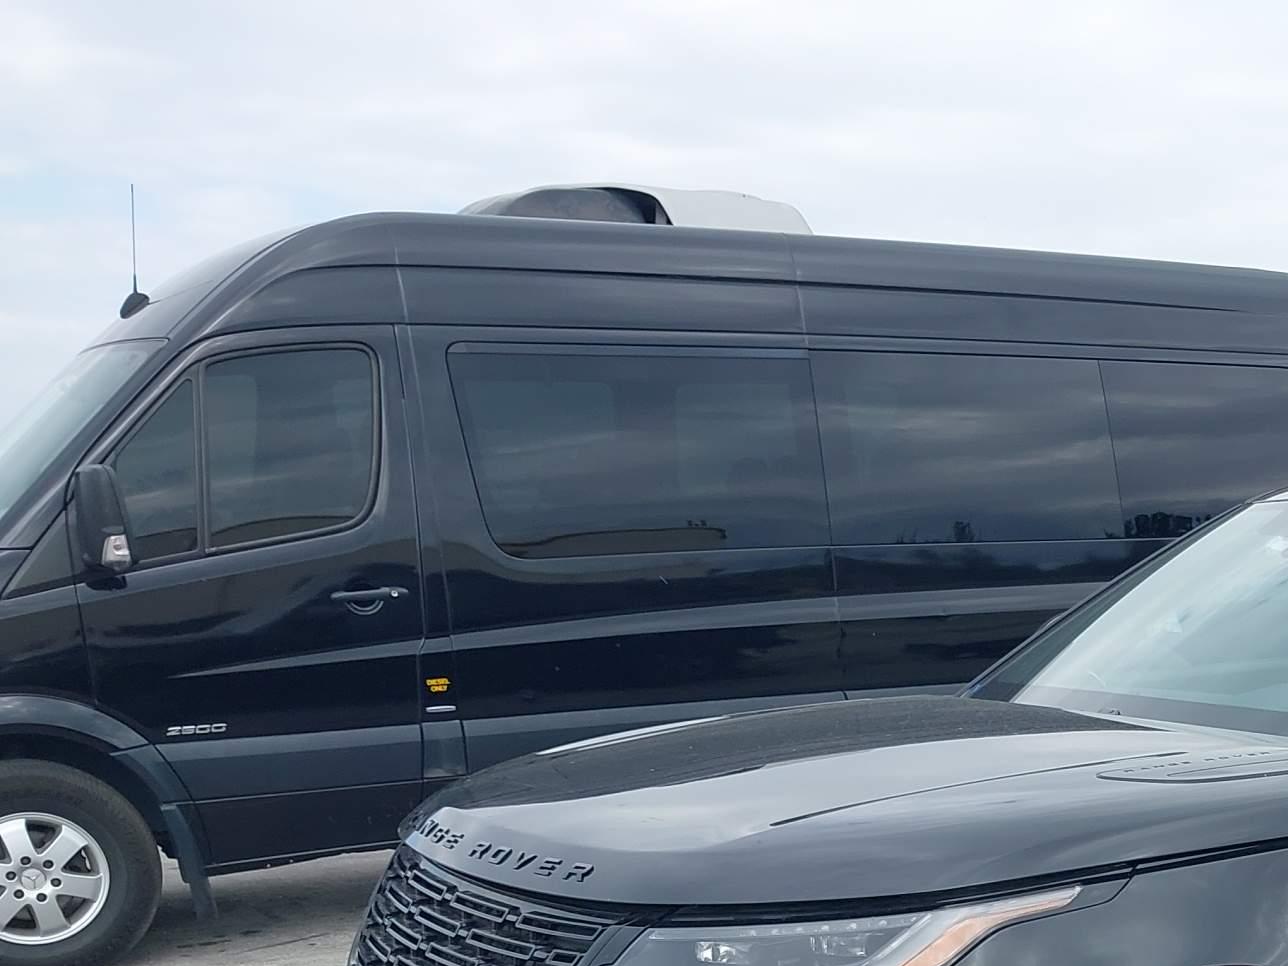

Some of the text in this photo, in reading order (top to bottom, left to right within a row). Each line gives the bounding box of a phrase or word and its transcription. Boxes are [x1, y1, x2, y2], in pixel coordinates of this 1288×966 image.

[166, 723, 227, 736] 2500
[419, 819, 594, 882] NGE ROVER
